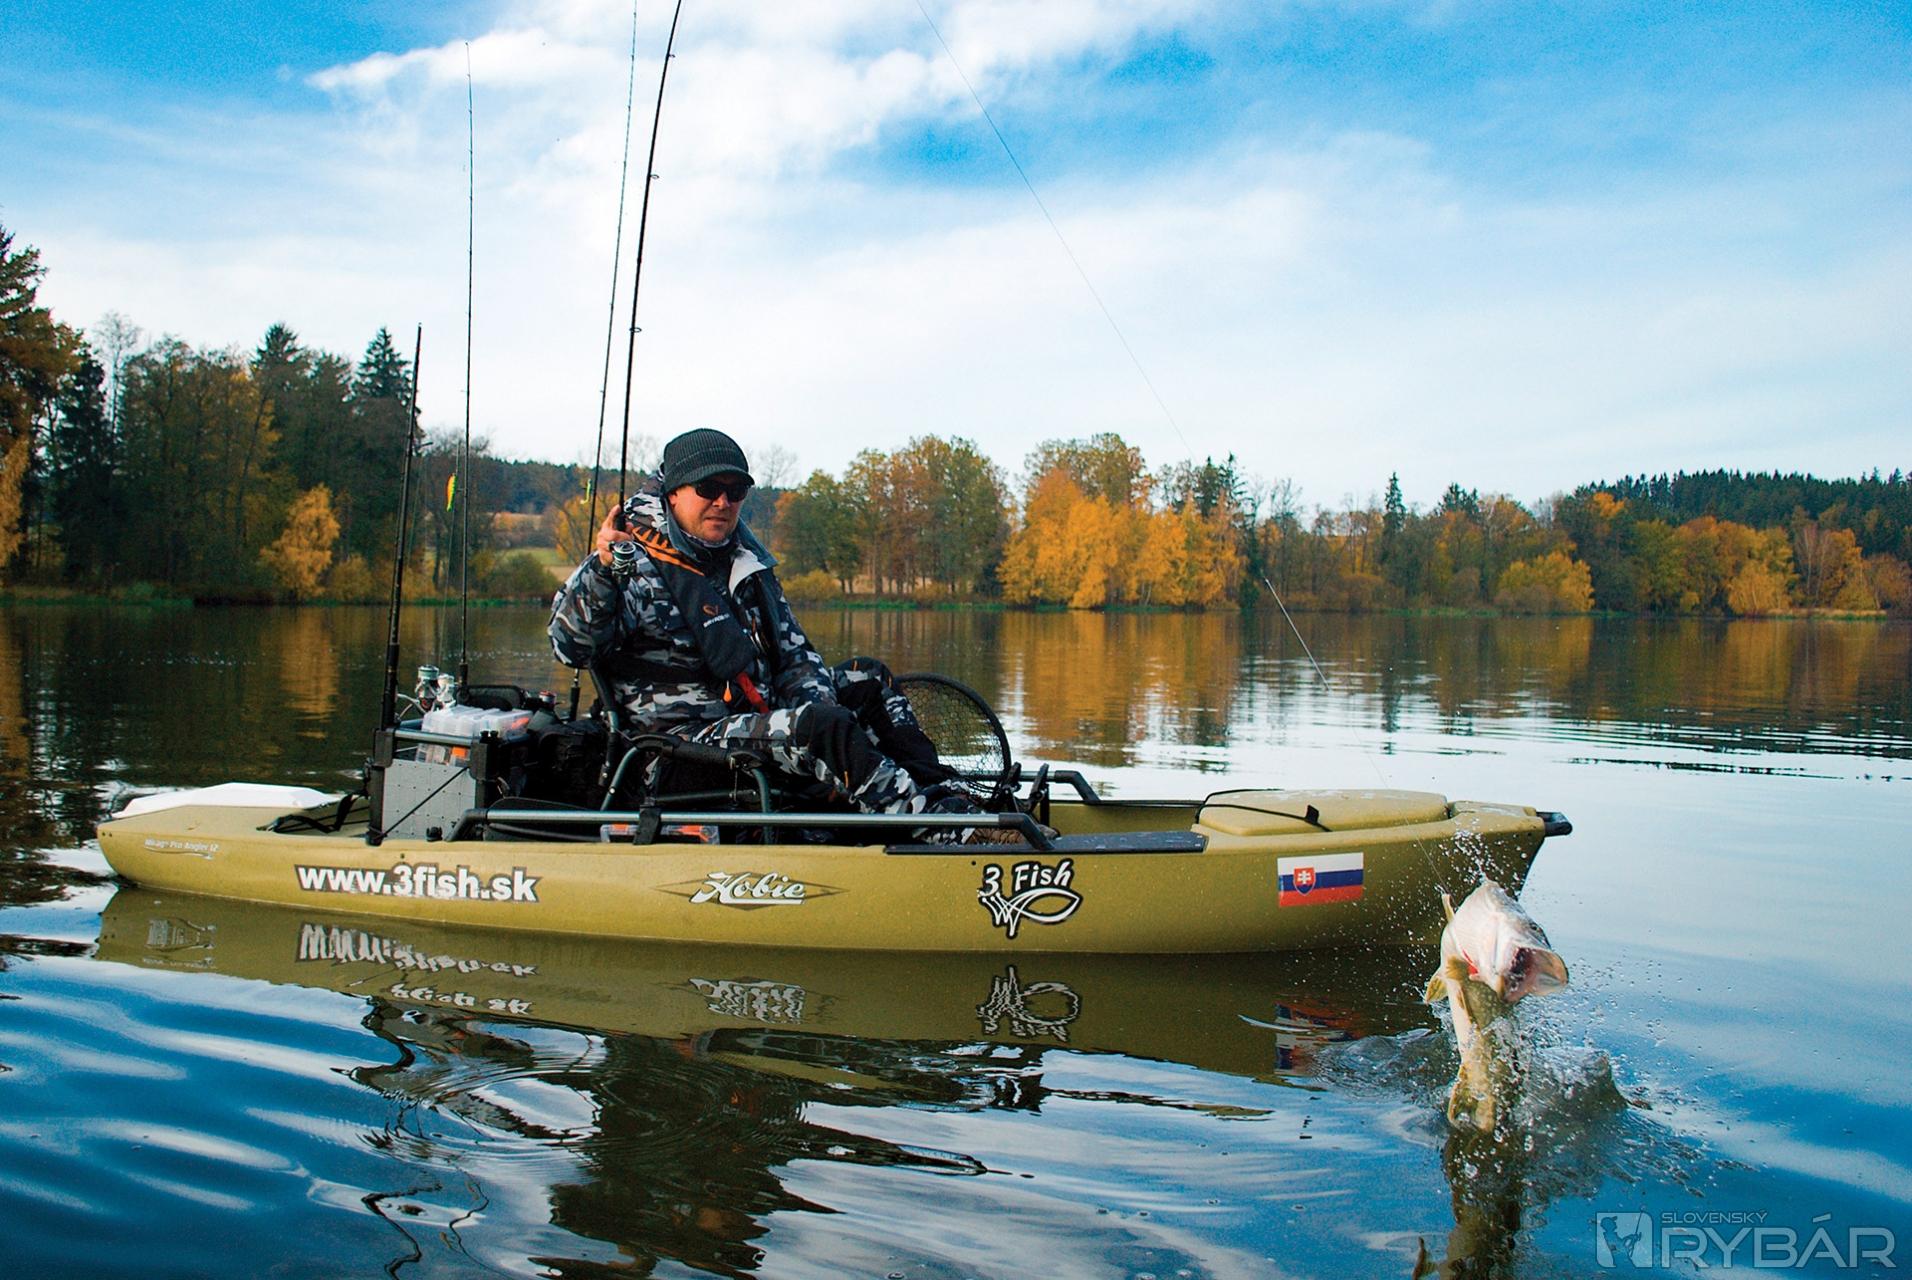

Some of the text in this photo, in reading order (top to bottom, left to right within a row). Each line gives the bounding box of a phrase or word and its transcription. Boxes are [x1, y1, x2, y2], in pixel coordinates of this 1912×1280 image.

[298, 864, 538, 902] www.3fish.sk
[690, 871, 806, 904] Hobie
[979, 861, 1072, 897] 3 Fish
